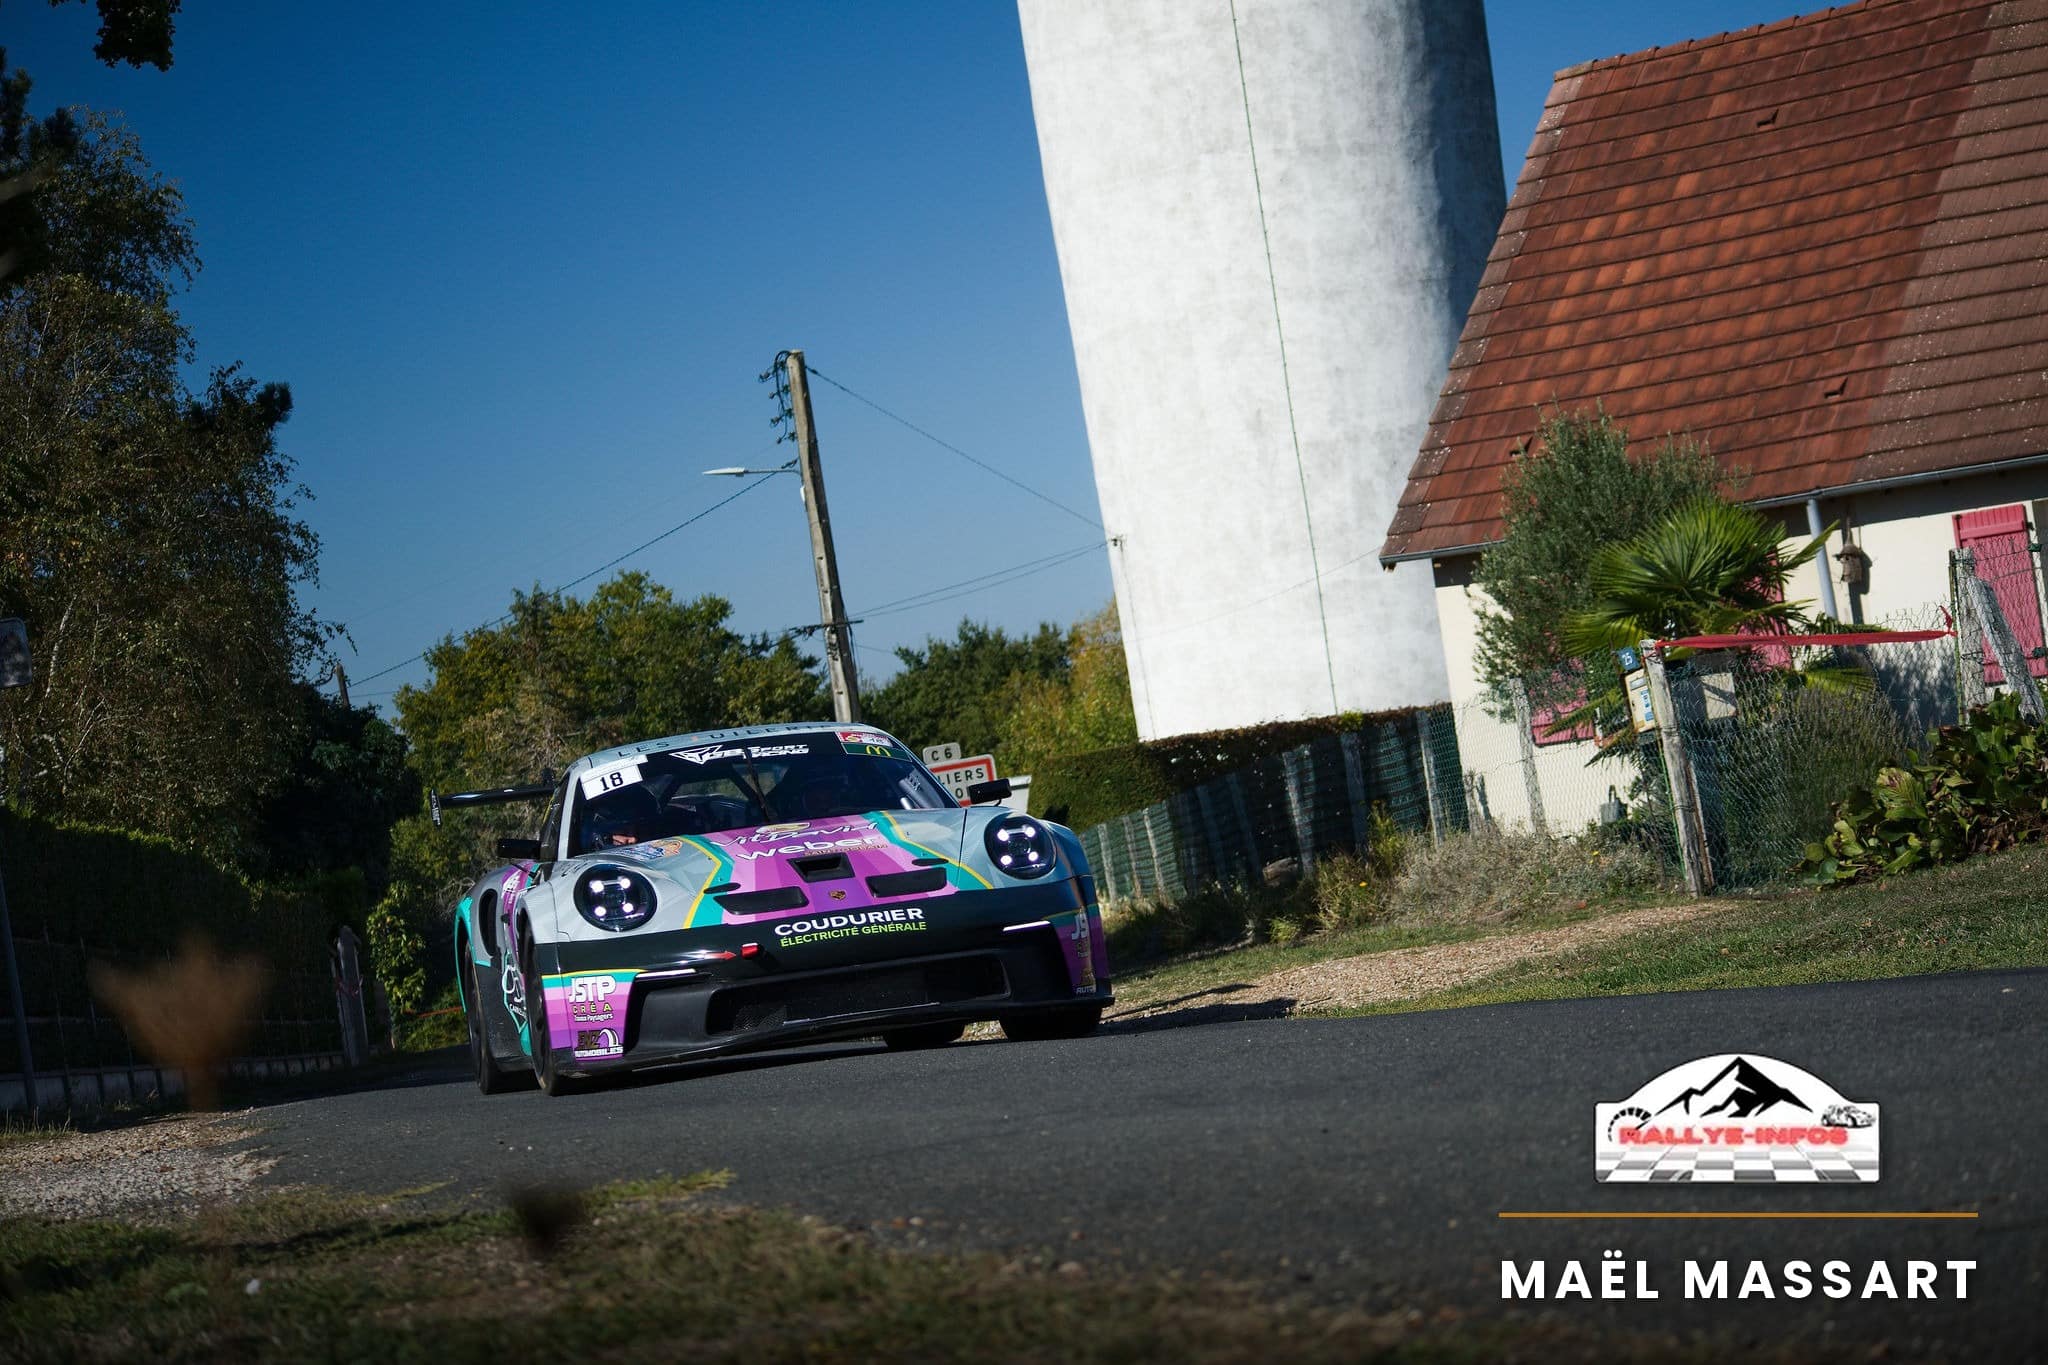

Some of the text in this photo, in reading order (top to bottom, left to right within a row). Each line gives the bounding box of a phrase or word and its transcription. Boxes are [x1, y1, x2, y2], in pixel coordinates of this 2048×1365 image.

[931, 748, 953, 761] C 6
[600, 771, 624, 791] 18
[774, 907, 925, 936] COUDURIER
[780, 921, 928, 948] ÉLECTRICITÉ GÉNÉRALE
[568, 975, 616, 1003] JSTP
